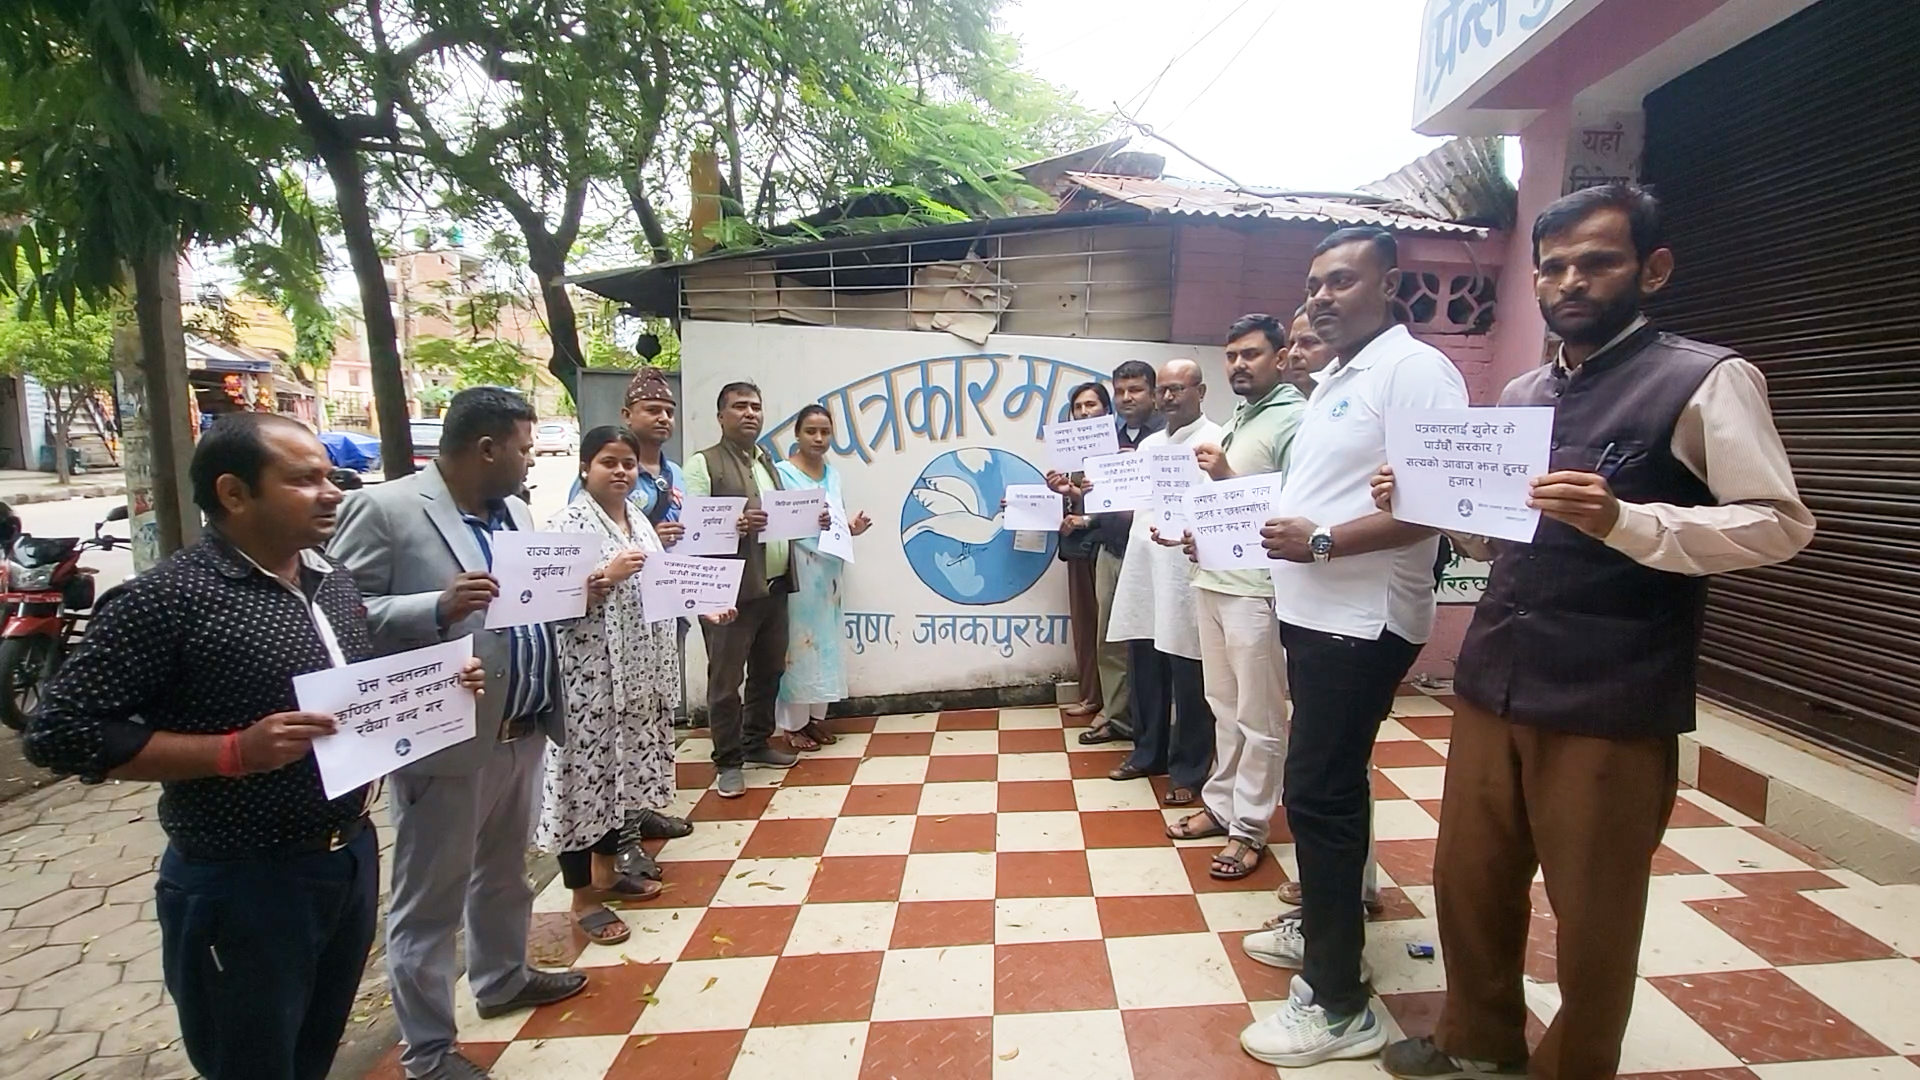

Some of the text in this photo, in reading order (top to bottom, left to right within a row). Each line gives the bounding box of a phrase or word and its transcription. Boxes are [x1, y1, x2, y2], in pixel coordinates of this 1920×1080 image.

[1415, 422, 1516, 438] पत्रकारलाई थुनेर के
[1456, 443, 1493, 452] सरकार
[1406, 457, 1439, 468] सत्यको
[1443, 459, 1474, 470] आवाज
[1448, 476, 1475, 487] हजार
[526, 544, 581, 556] राज्य आतंक
[844, 612, 1073, 658] नुषा, जनकपुरधा
[356, 661, 443, 696] प्रेस स्वतन्त्रता
[425, 699, 445, 712] गर
